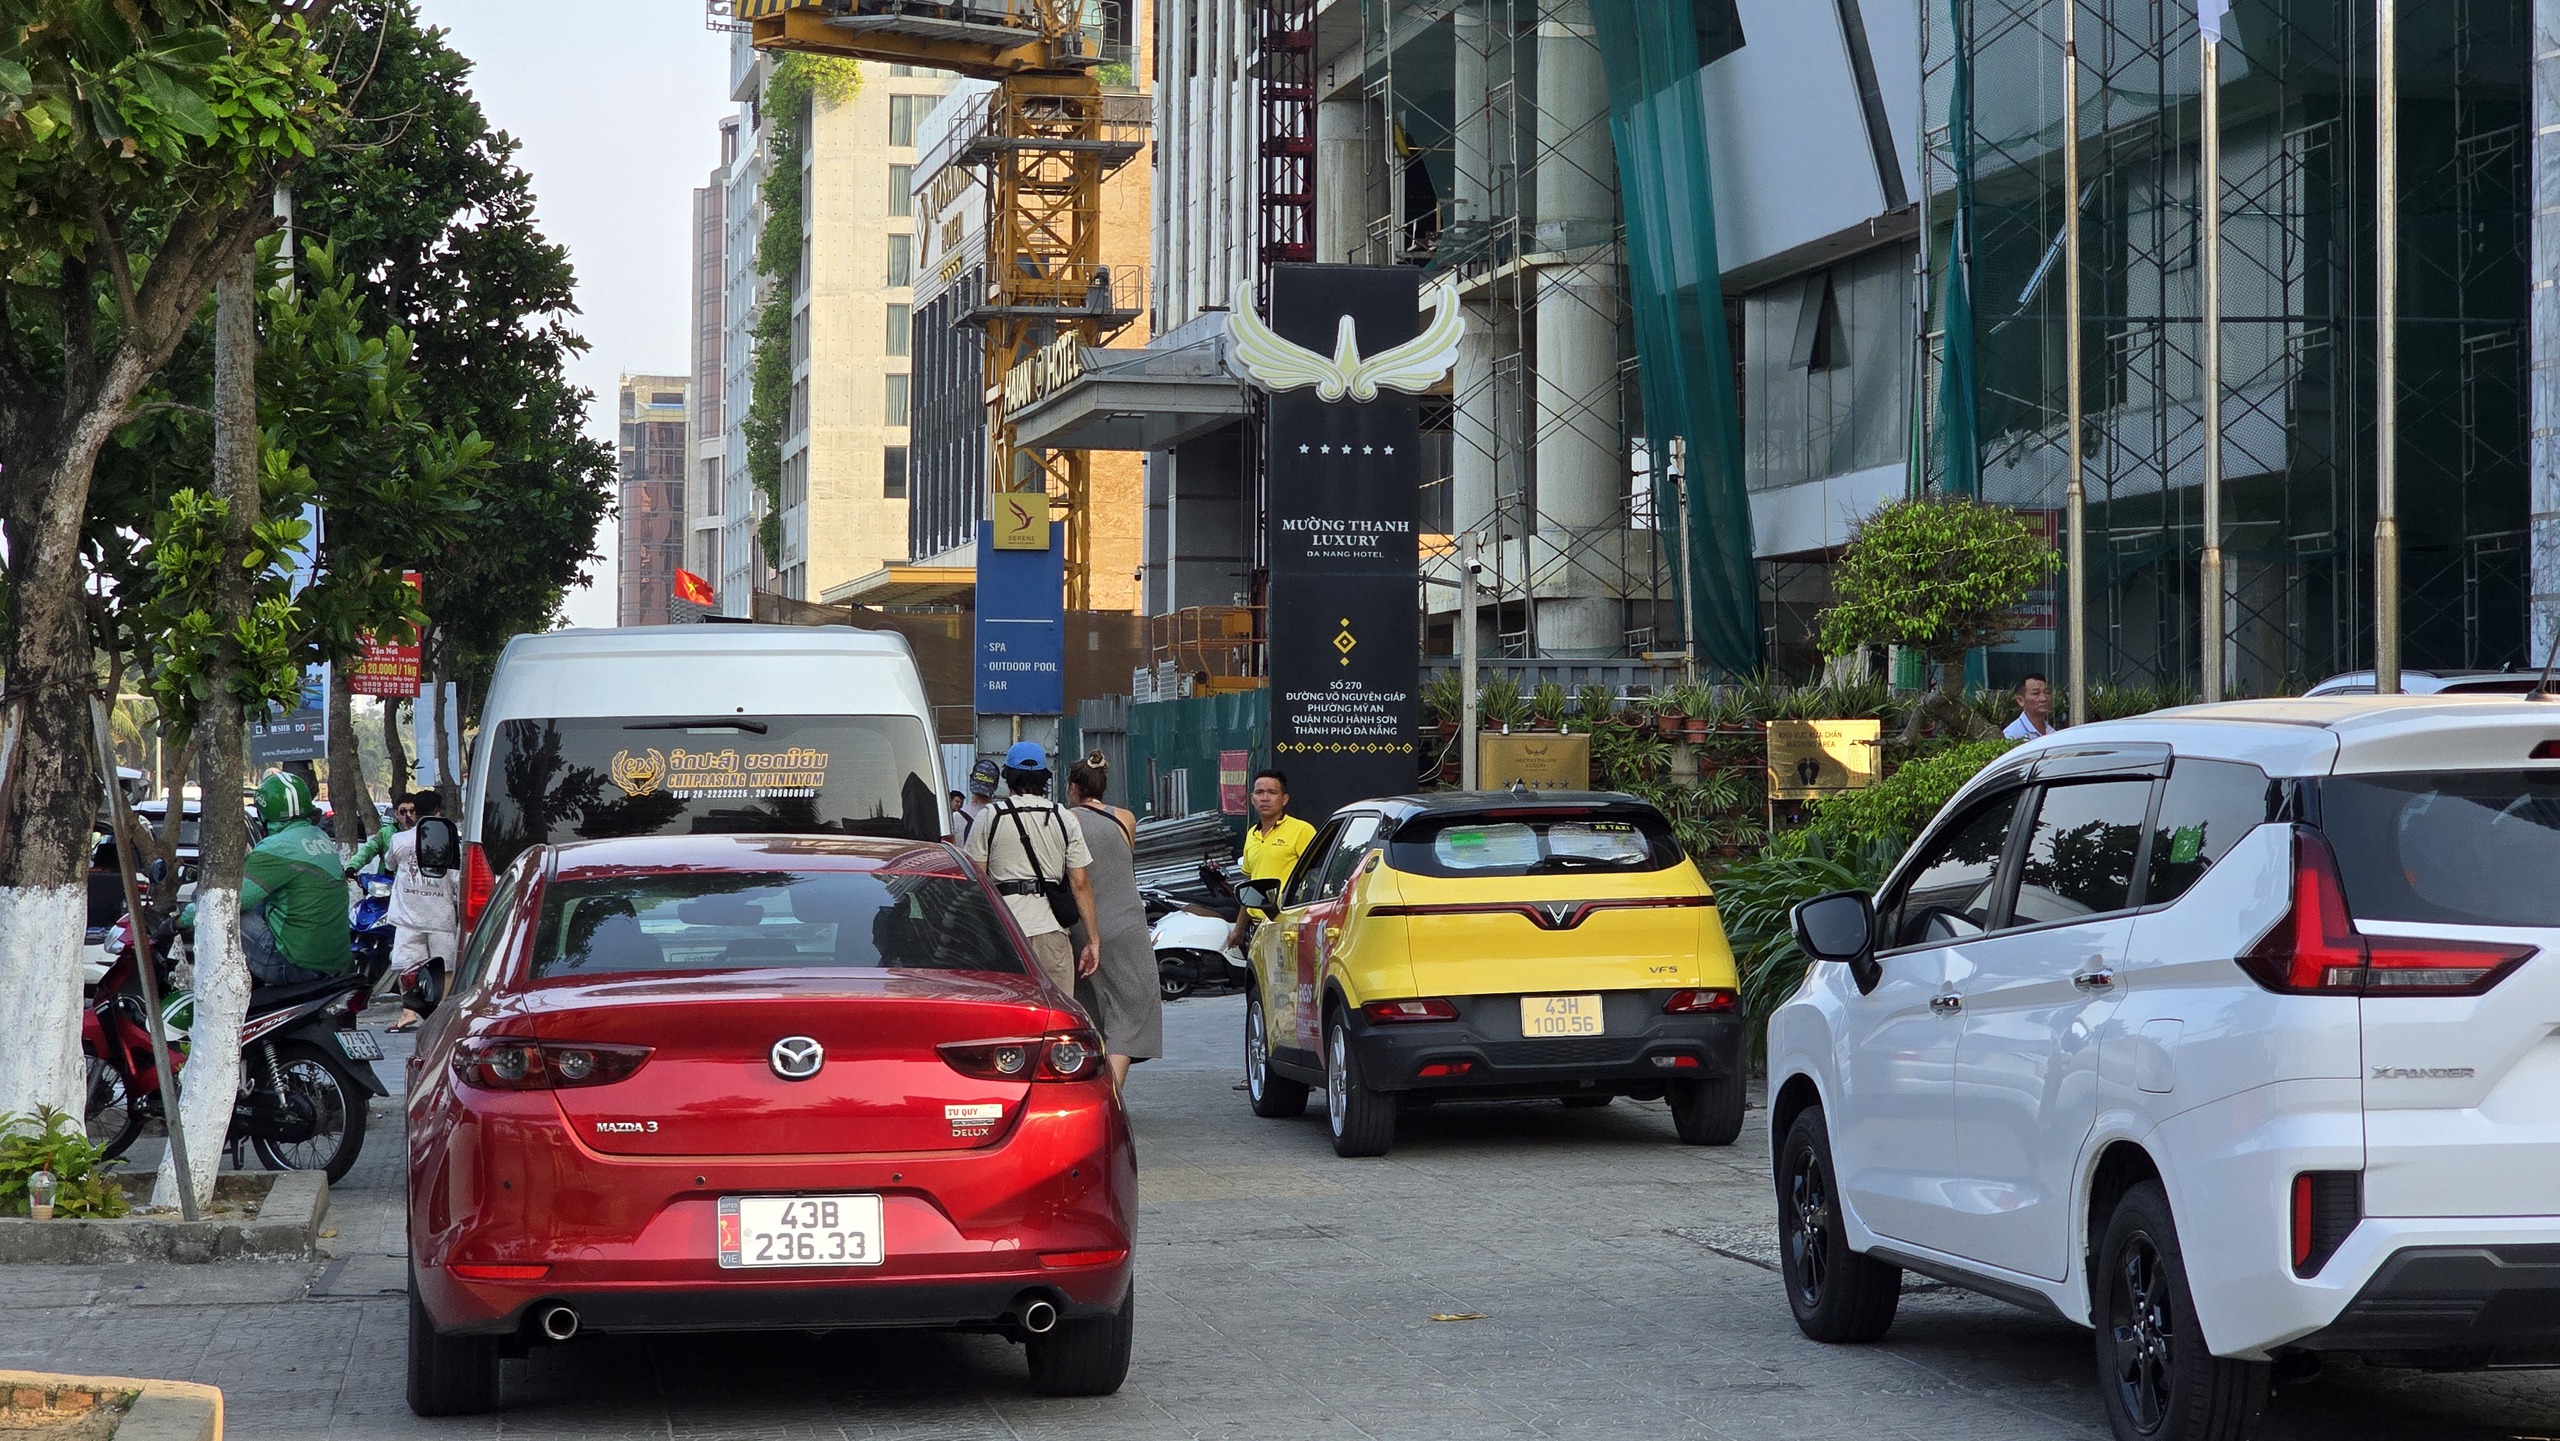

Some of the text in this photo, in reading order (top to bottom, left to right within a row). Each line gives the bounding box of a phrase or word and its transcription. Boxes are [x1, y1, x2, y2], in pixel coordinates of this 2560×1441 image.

[942, 211, 964, 254] HOTEL
[1047, 329, 1081, 392] HOTEL
[1282, 516, 1409, 532] MƯỜNG THANH
[1312, 534, 1379, 546] LUXURY
[989, 642, 1006, 652] SPA
[403, 664, 417, 676] 1kg
[989, 661, 1058, 672] OUTDOOR POOL
[989, 681, 1007, 690] BAR
[1330, 679, 1362, 690] SỐ 270
[1286, 690, 1324, 701] ĐƯỜNG
[1341, 691, 1381, 702] NGUYÊN
[1383, 691, 1407, 702] GIÁP
[1307, 703, 1352, 713] PHƯỜNG
[1369, 704, 1384, 713] AN
[1346, 714, 1375, 724] HÀNH
[1376, 715, 1397, 724] SƠN
[1294, 724, 1329, 735] THÀNH
[1331, 724, 1352, 735] PHỐ
[1353, 725, 1368, 735] ĐÀ
[1825, 730, 1842, 738] CHÂN
[623, 757, 655, 773] CPS
[667, 772, 824, 788] CHITPRASONG NYOTNINYOM
[1546, 998, 1579, 1015] 43H
[1535, 1016, 1594, 1033] 100.56
[342, 1032, 369, 1045] 77-G1
[2372, 1065, 2475, 1079] XPANDER
[962, 1108, 978, 1116] QUY
[596, 1120, 658, 1133] MAZDA 3
[952, 1128, 989, 1137] DELUX
[781, 1201, 839, 1229] 43B
[755, 1231, 866, 1261] 236.33
[721, 1254, 738, 1263] VIE
